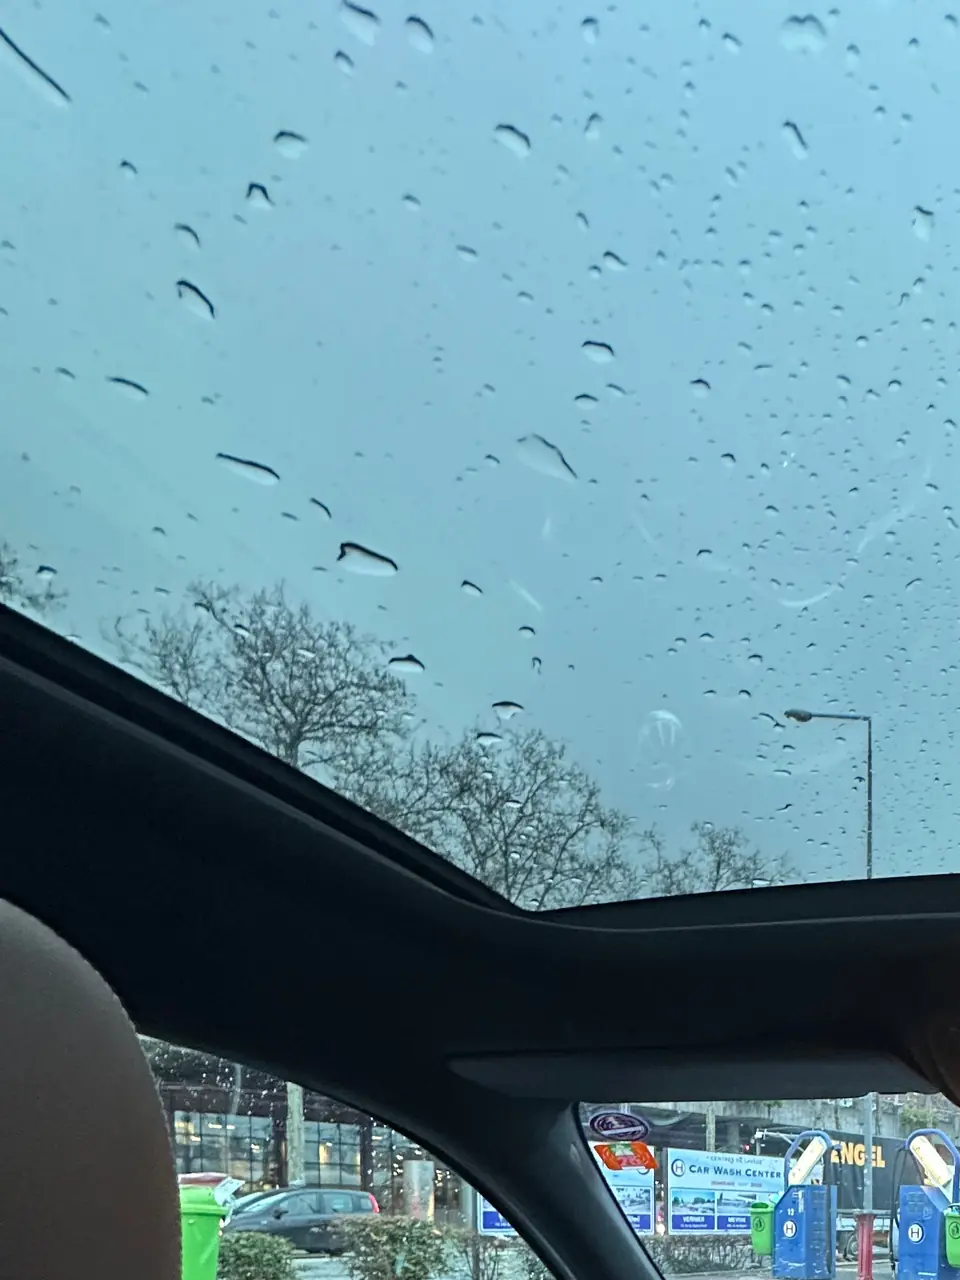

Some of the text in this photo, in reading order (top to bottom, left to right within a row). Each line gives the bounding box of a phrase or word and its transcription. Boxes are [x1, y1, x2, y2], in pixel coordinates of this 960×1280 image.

[689, 1164, 709, 1174] CAR
[713, 1166, 742, 1177] WASH
[745, 1168, 781, 1179] CENTER
